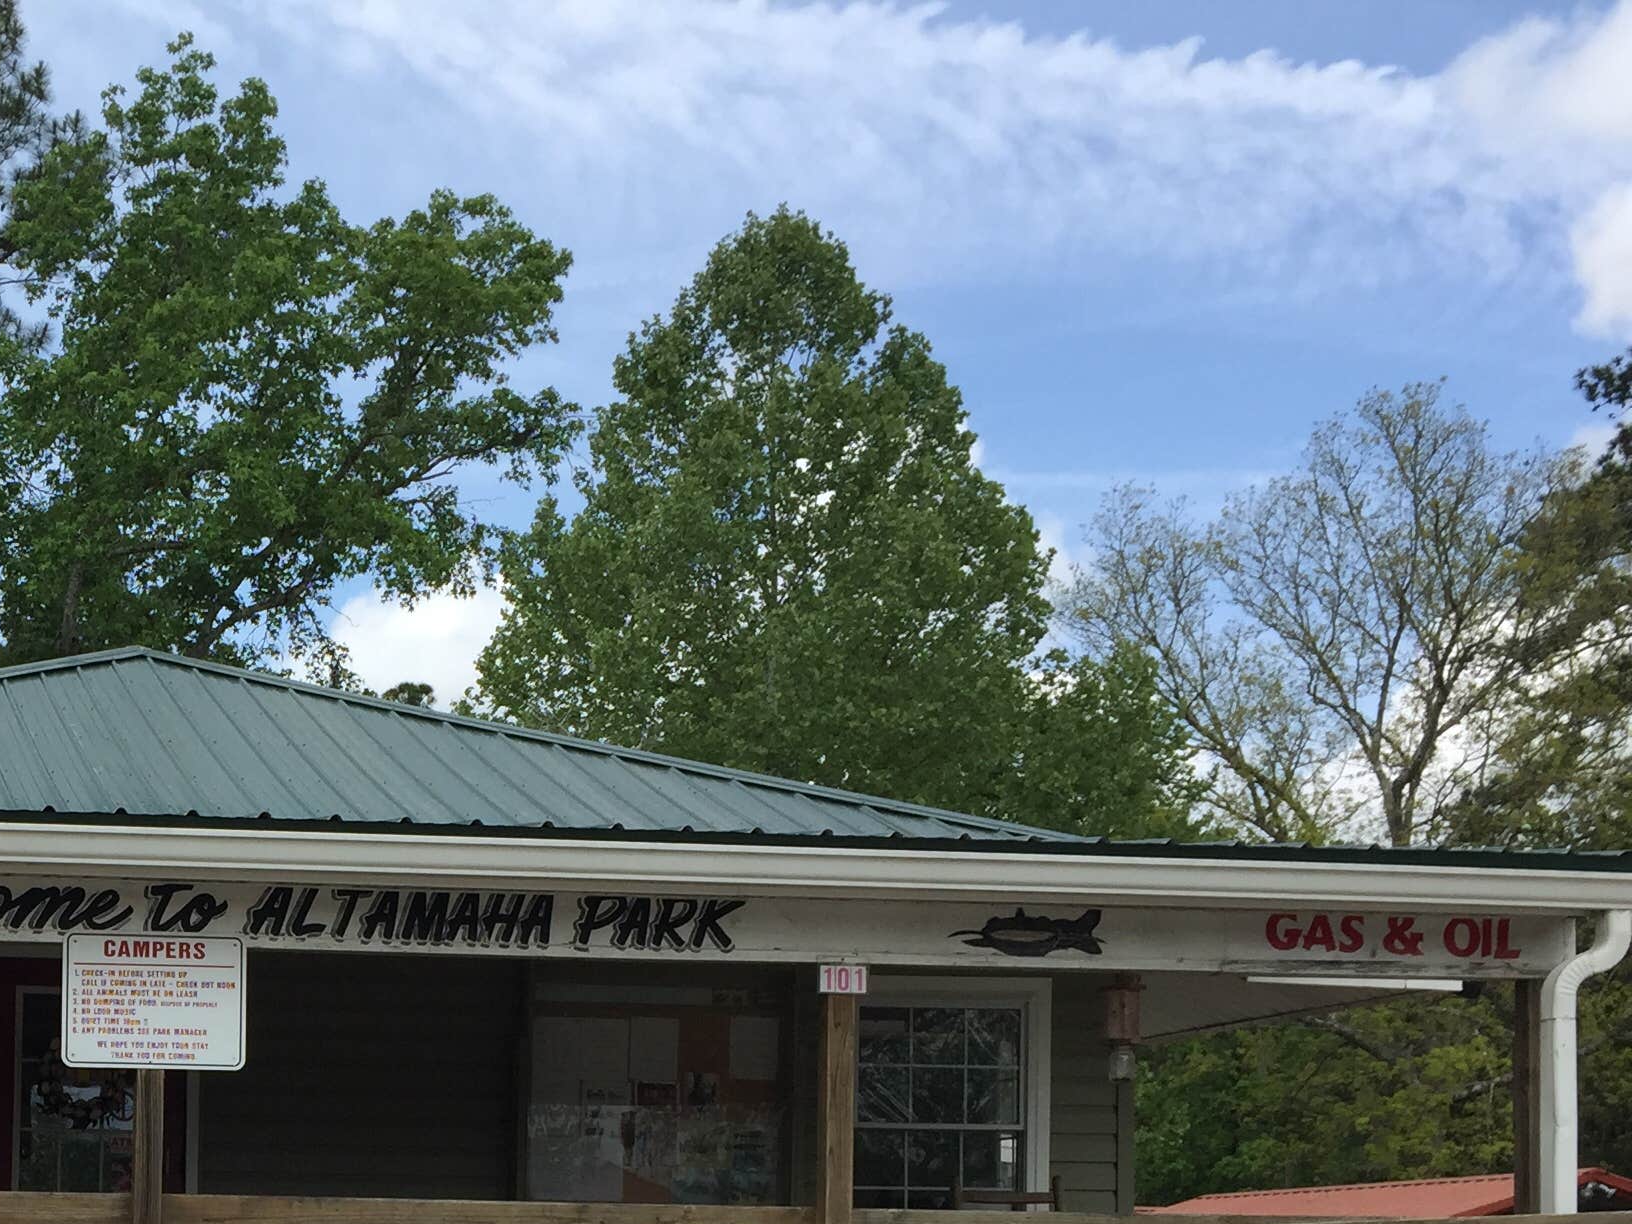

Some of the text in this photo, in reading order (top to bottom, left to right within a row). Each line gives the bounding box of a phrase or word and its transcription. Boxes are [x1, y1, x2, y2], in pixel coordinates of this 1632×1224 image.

[147, 883, 229, 932] to
[245, 886, 554, 948] ALTAMAHA
[573, 894, 748, 952] PARK
[1265, 912, 1522, 960] GAS & OIL
[103, 939, 206, 960] CAMPERS
[147, 970, 176, 978] SETTING
[822, 967, 867, 993] 101
